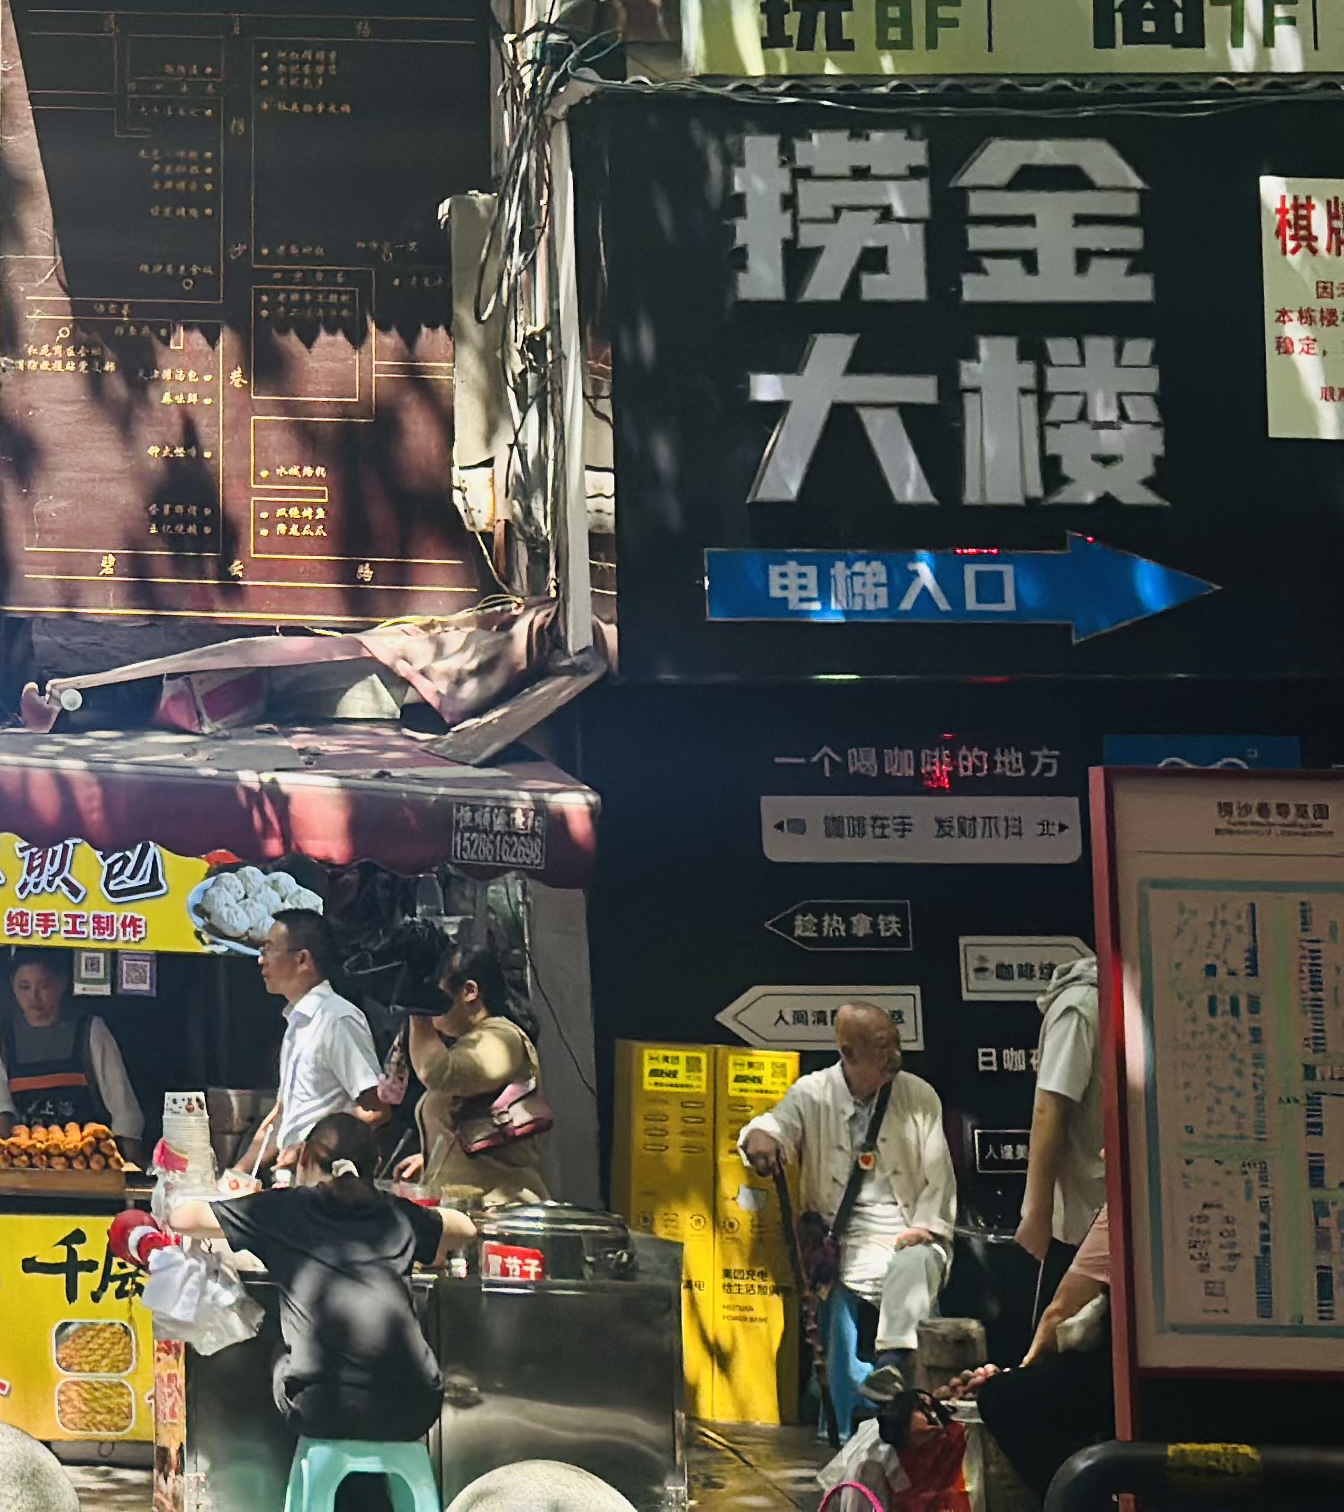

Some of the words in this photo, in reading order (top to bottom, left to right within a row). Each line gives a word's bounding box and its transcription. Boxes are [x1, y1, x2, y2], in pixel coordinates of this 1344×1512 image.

[733, 129, 1156, 302] 捞金
[746, 333, 1172, 507] 大楼
[768, 561, 1016, 612] 电梯入口
[774, 745, 1060, 778] 一个喝咖啡的地方
[4, 909, 148, 942] 纯手工制作
